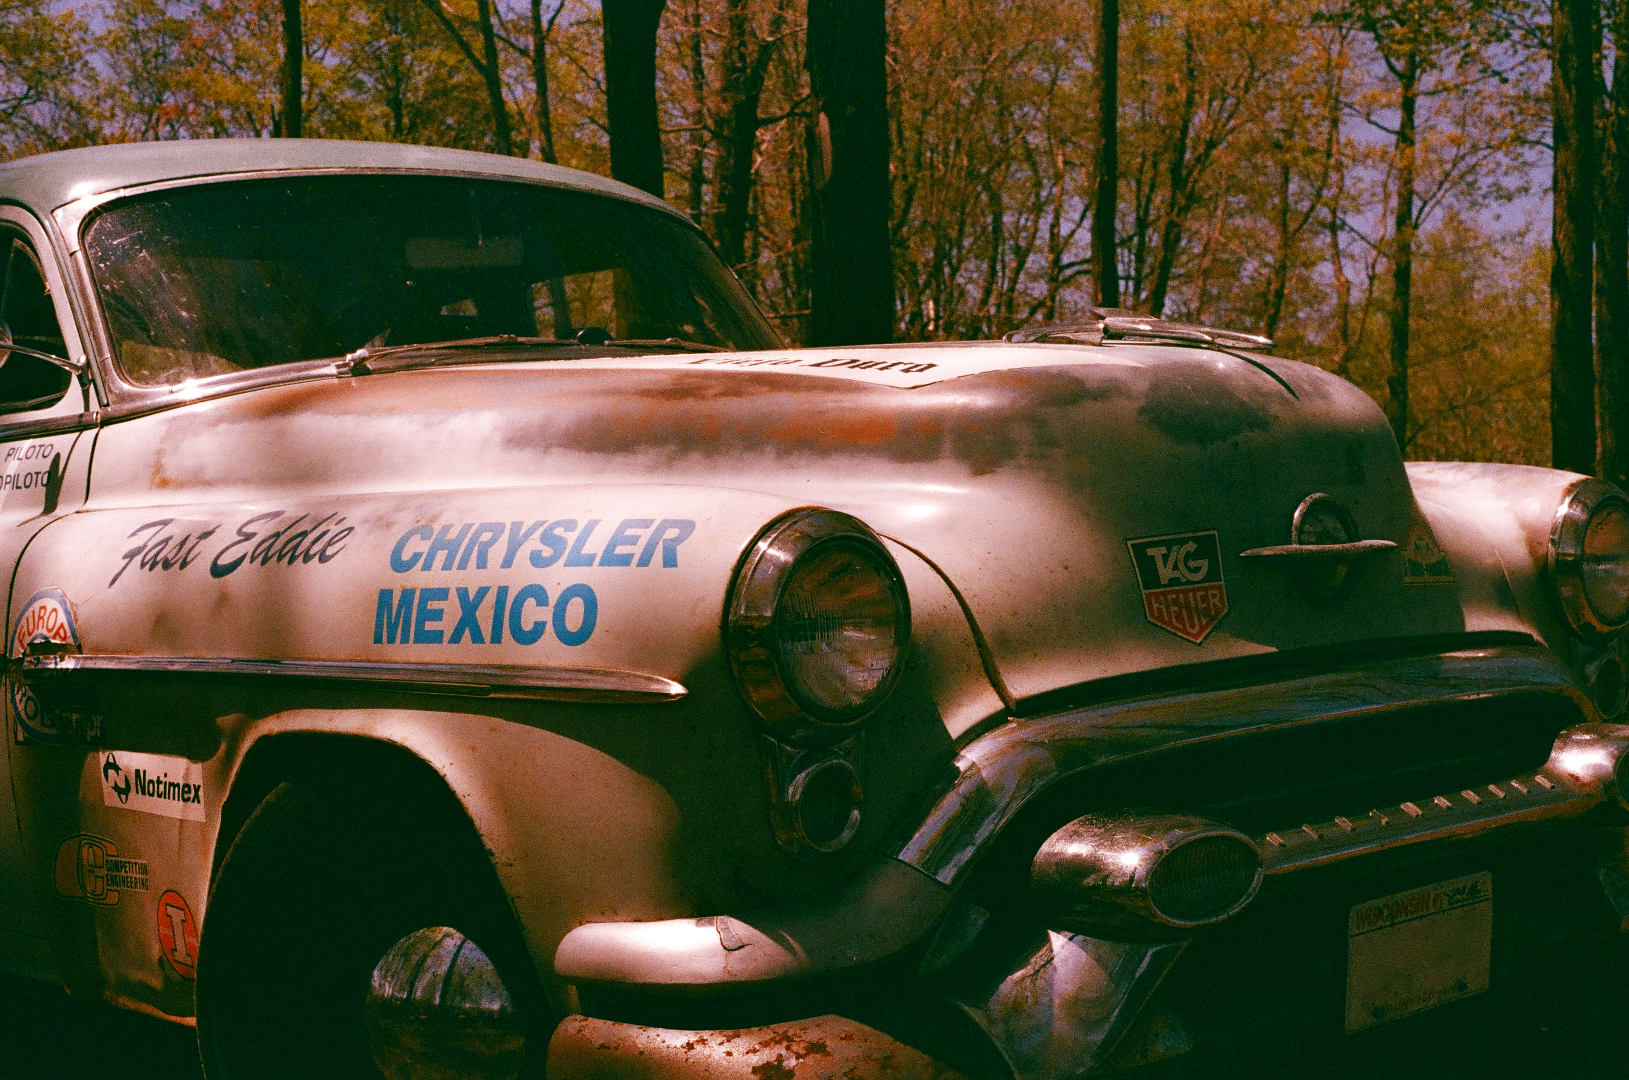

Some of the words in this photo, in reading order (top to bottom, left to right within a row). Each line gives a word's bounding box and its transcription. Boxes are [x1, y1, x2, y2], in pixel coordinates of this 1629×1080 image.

[4, 443, 54, 462] PILOTO
[108, 518, 223, 588] Fast
[210, 510, 355, 578] Eddie
[390, 518, 696, 573] CHRYSLER
[1146, 540, 1209, 584] TAG
[373, 583, 597, 646] MEXICO
[1150, 589, 1223, 634] HEUER
[134, 768, 201, 804] Notimex
[105, 859, 148, 876] COMPETITION
[105, 874, 149, 891] ENGINEERING
